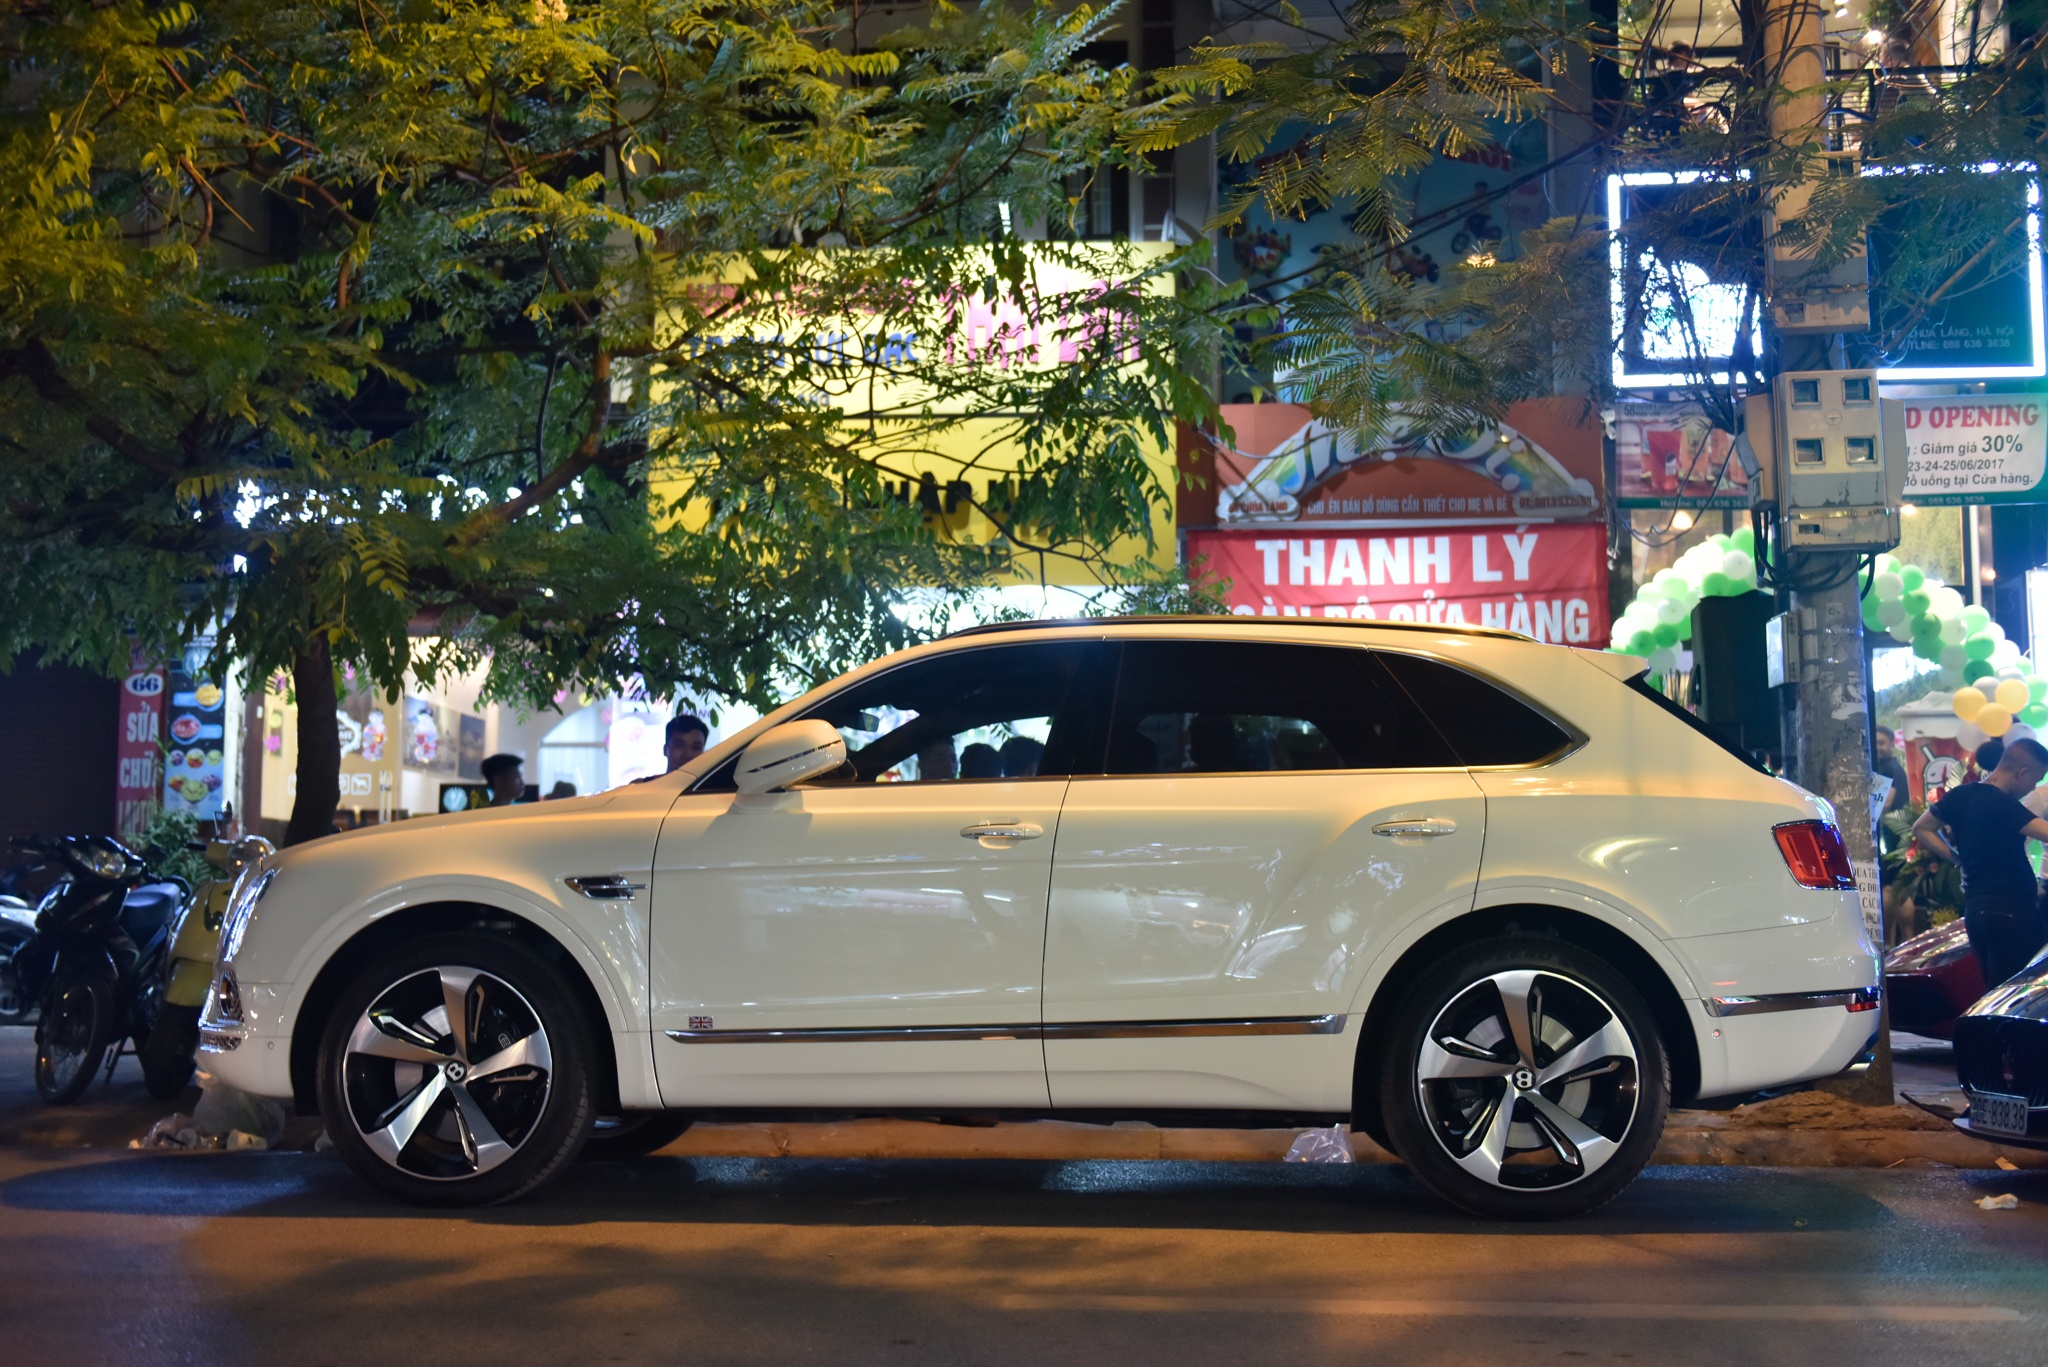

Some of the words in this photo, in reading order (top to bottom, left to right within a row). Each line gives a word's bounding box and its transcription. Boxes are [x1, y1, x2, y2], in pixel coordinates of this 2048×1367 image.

[1898, 340, 1940, 351] TLINE:
[1929, 403, 2040, 429] OPENING
[1920, 442, 1954, 455] Giảm
[1958, 441, 1977, 456] giá
[1981, 434, 2023, 453] 30%
[1908, 459, 2005, 472] 23-24-25/06/2017
[1920, 474, 1951, 488] uống
[1954, 475, 1969, 487] tại
[1972, 473, 1997, 485] Cửa
[2000, 472, 2033, 486] hàng.
[1308, 496, 1341, 515] CHUÊN
[1423, 493, 1447, 513] THIẾT
[1449, 497, 1466, 512] CHO
[1483, 495, 1494, 512] VÀ
[1255, 535, 1450, 586] THANH
[1471, 523, 1540, 583] LÝ
[1481, 592, 1590, 644] HÀNG
[132, 677, 159, 692] 66
[126, 700, 159, 743] SỬA
